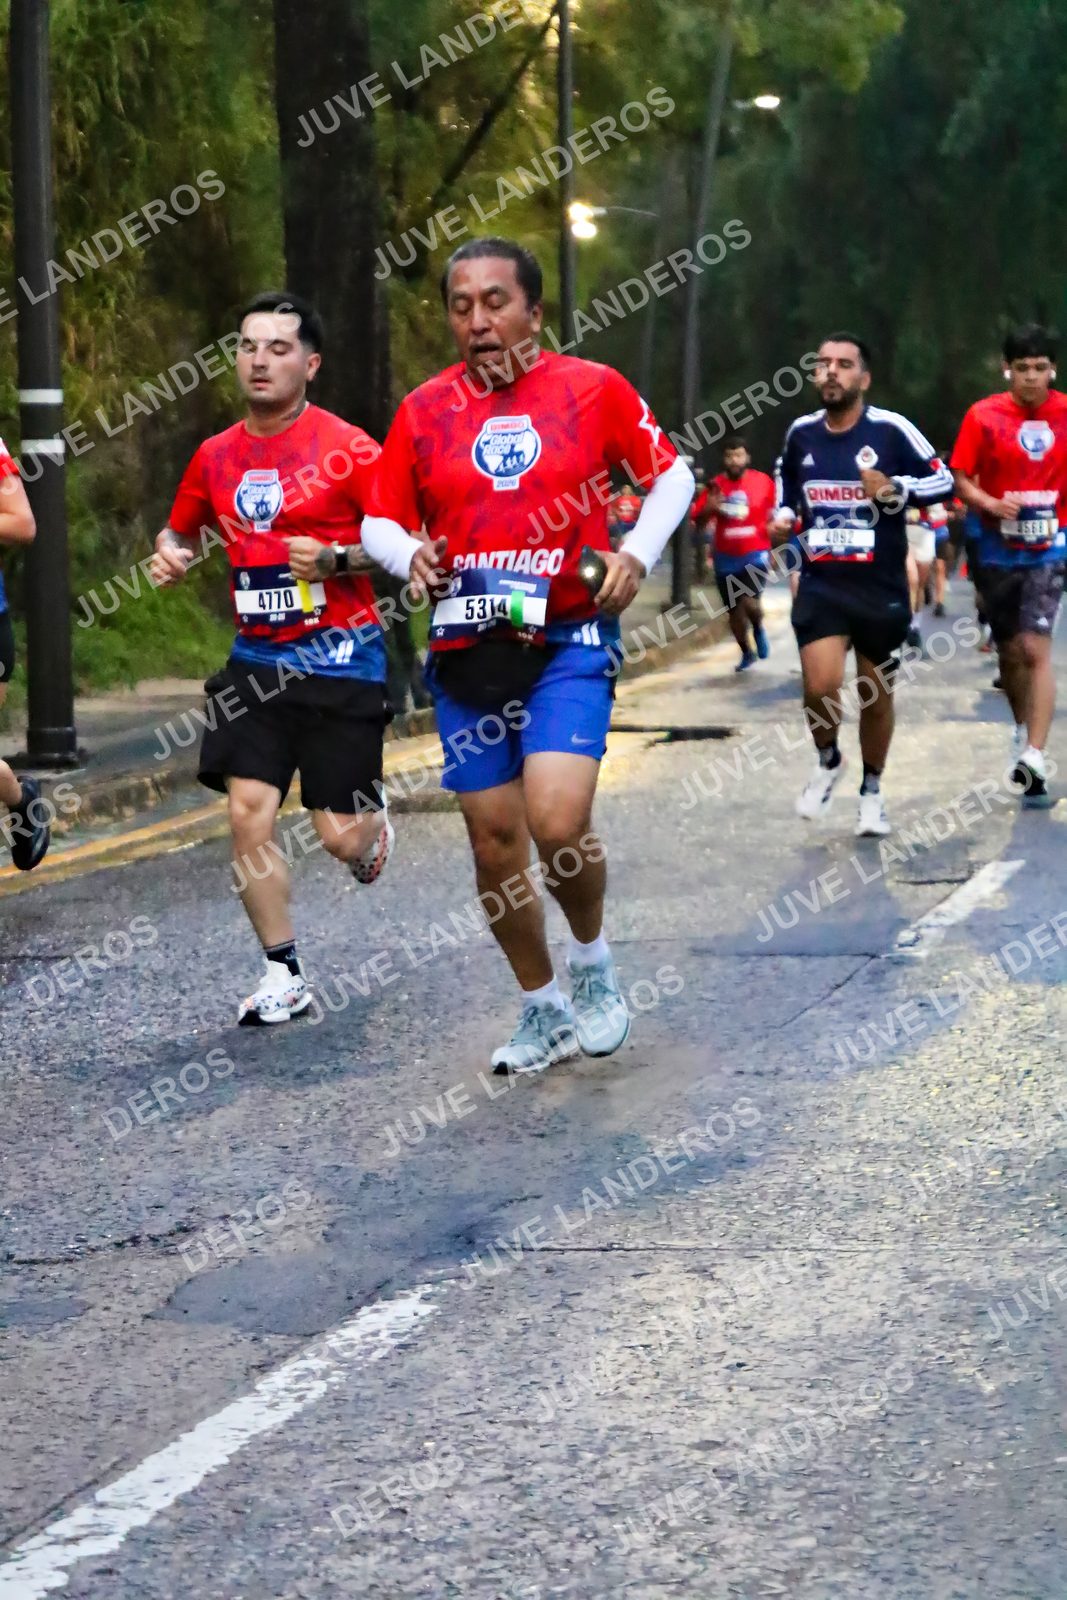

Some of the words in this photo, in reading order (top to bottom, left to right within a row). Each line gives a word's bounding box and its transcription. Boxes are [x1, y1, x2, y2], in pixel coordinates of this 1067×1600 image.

[489, 432, 524, 446] Global
[807, 487, 866, 501] BIMBO
[453, 548, 565, 576] SANTIAGO
[258, 589, 294, 610] 4770
[465, 598, 508, 620] 5314
